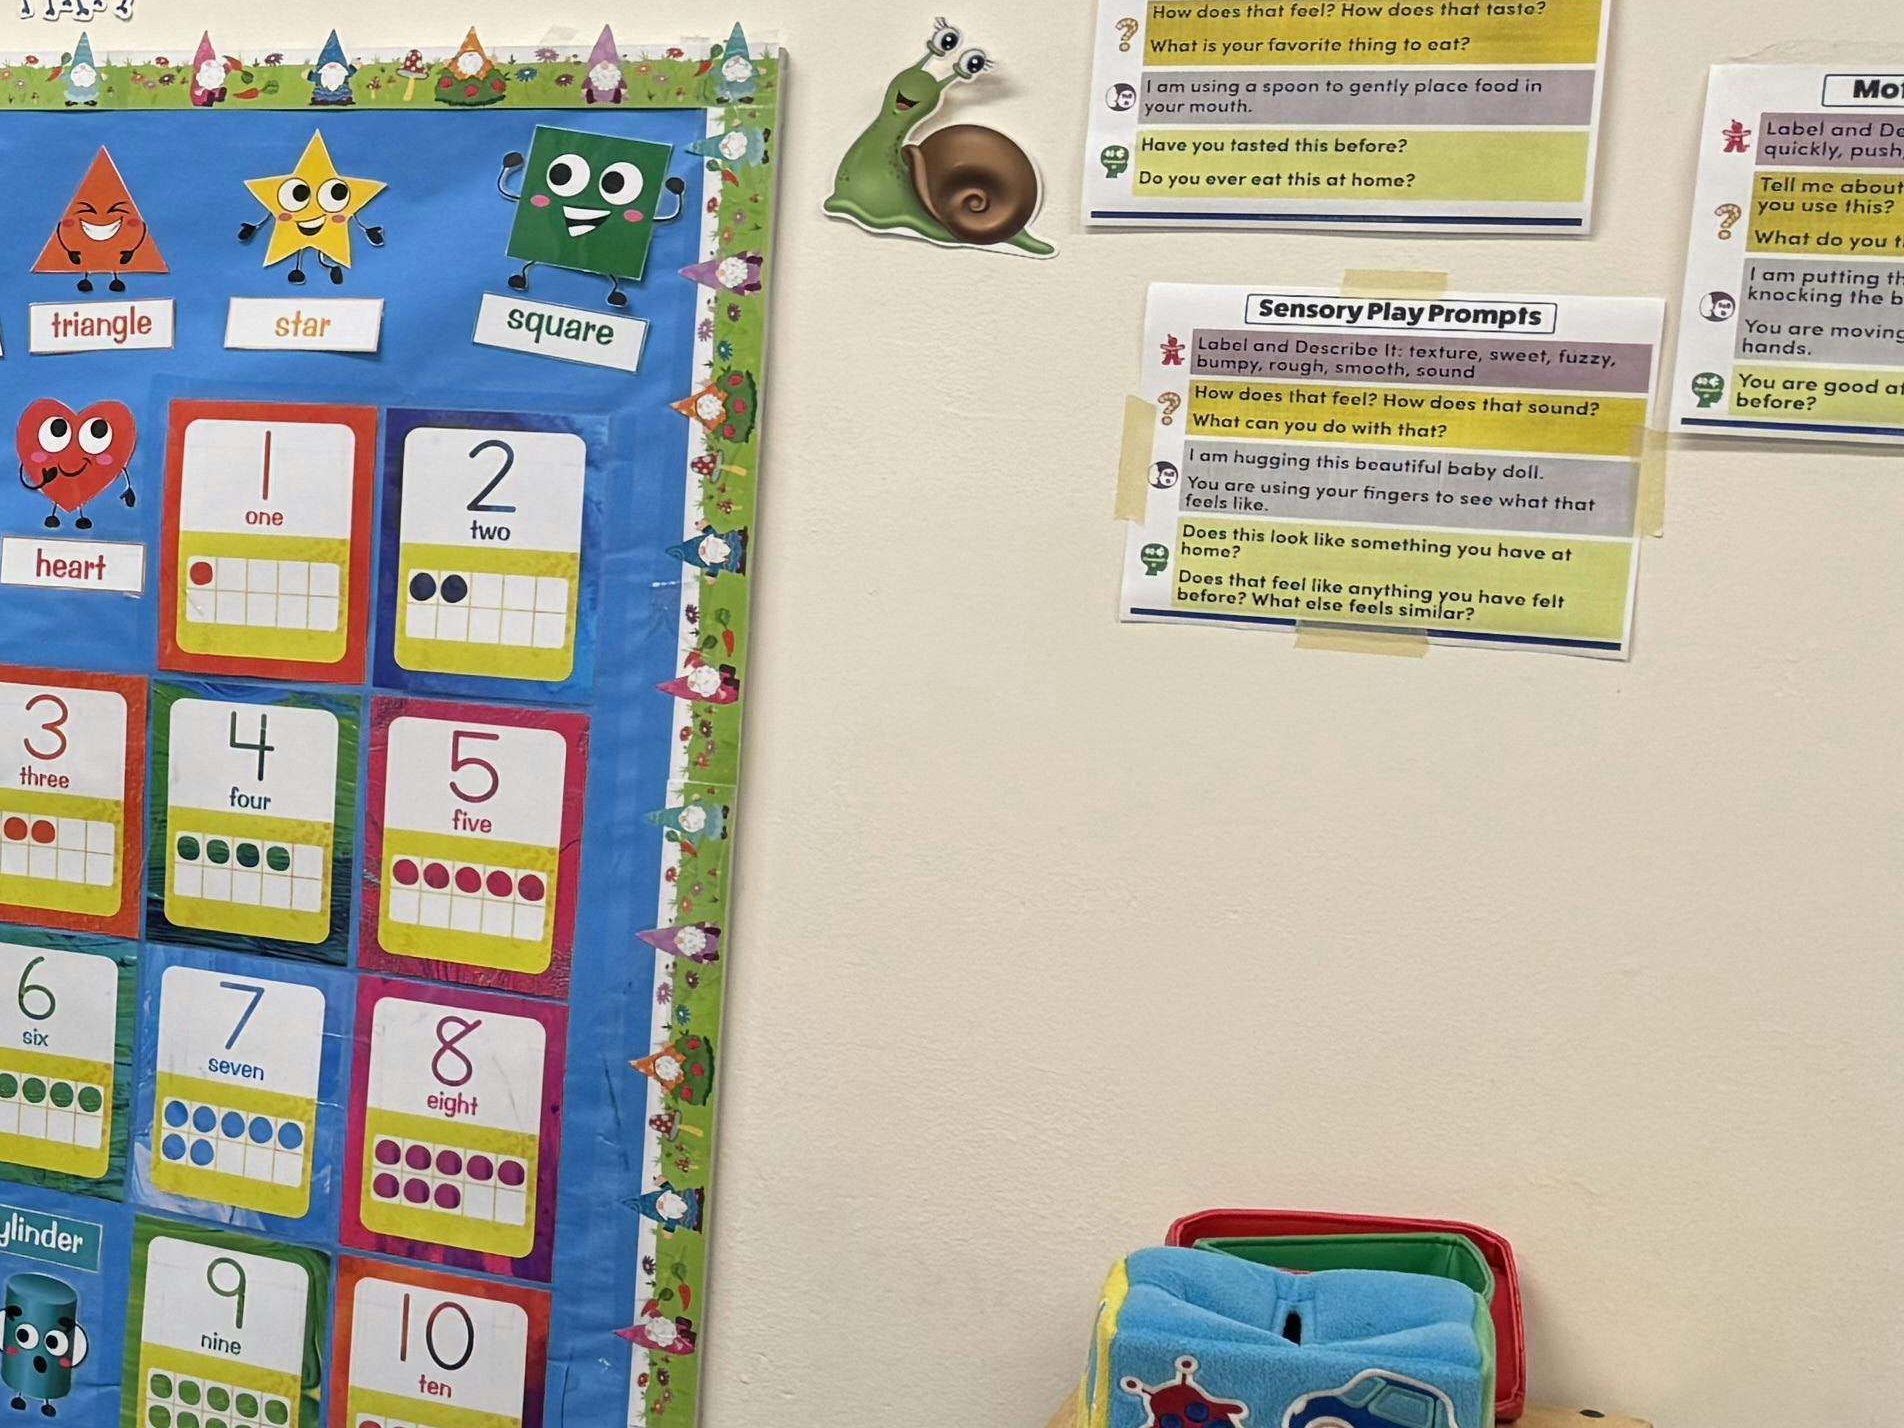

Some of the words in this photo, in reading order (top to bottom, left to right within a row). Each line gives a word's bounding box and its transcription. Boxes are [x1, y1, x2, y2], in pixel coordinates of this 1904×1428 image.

[1151, 39, 1197, 53] What
[1204, 39, 1216, 52] is
[1223, 40, 1263, 56] your
[1269, 38, 1341, 52] favorite
[1349, 38, 1396, 55] thing
[1404, 38, 1421, 51] to
[1428, 37, 1470, 52] eat?
[1139, 172, 1162, 185] Do
[1169, 175, 1200, 188] you
[1206, 174, 1246, 186] ever
[1251, 174, 1281, 186] eat
[1288, 173, 1320, 187] this
[1327, 174, 1346, 187] at
[1352, 174, 1415, 188] home?
[1758, 199, 1796, 217] you
[1801, 200, 1837, 214] use
[1845, 200, 1894, 215] this?
[275, 312, 331, 337] star
[507, 306, 614, 345] square
[1259, 299, 1362, 324] Sensory
[1367, 302, 1423, 324] Play
[1428, 304, 1541, 328] Prompts
[52, 311, 152, 345] triangle
[1737, 394, 1816, 411] before?
[1193, 414, 1239, 429] What
[1245, 418, 1278, 430] can
[1285, 420, 1316, 435] you
[1323, 419, 1347, 433] do
[1352, 420, 1390, 436] with
[1398, 423, 1447, 438] that?
[262, 430, 271, 500] 1
[466, 440, 516, 513] 2
[245, 510, 283, 526] one
[471, 521, 510, 541] two
[36, 549, 105, 580] heart
[23, 694, 68, 760] 3
[230, 712, 274, 781] 4
[19, 767, 69, 789] three
[450, 731, 499, 803] 5
[230, 787, 271, 810] four
[452, 809, 492, 833] five
[18, 957, 56, 1020] 6
[219, 981, 265, 1050] 7
[22, 1030, 48, 1047] six
[432, 1015, 482, 1087] 8
[208, 1057, 264, 1081] seven
[427, 1091, 479, 1117] eight
[207, 1256, 247, 1329] 9
[201, 1332, 240, 1356] nine
[400, 1293, 474, 1370] 10
[419, 1376, 452, 1398] ten
